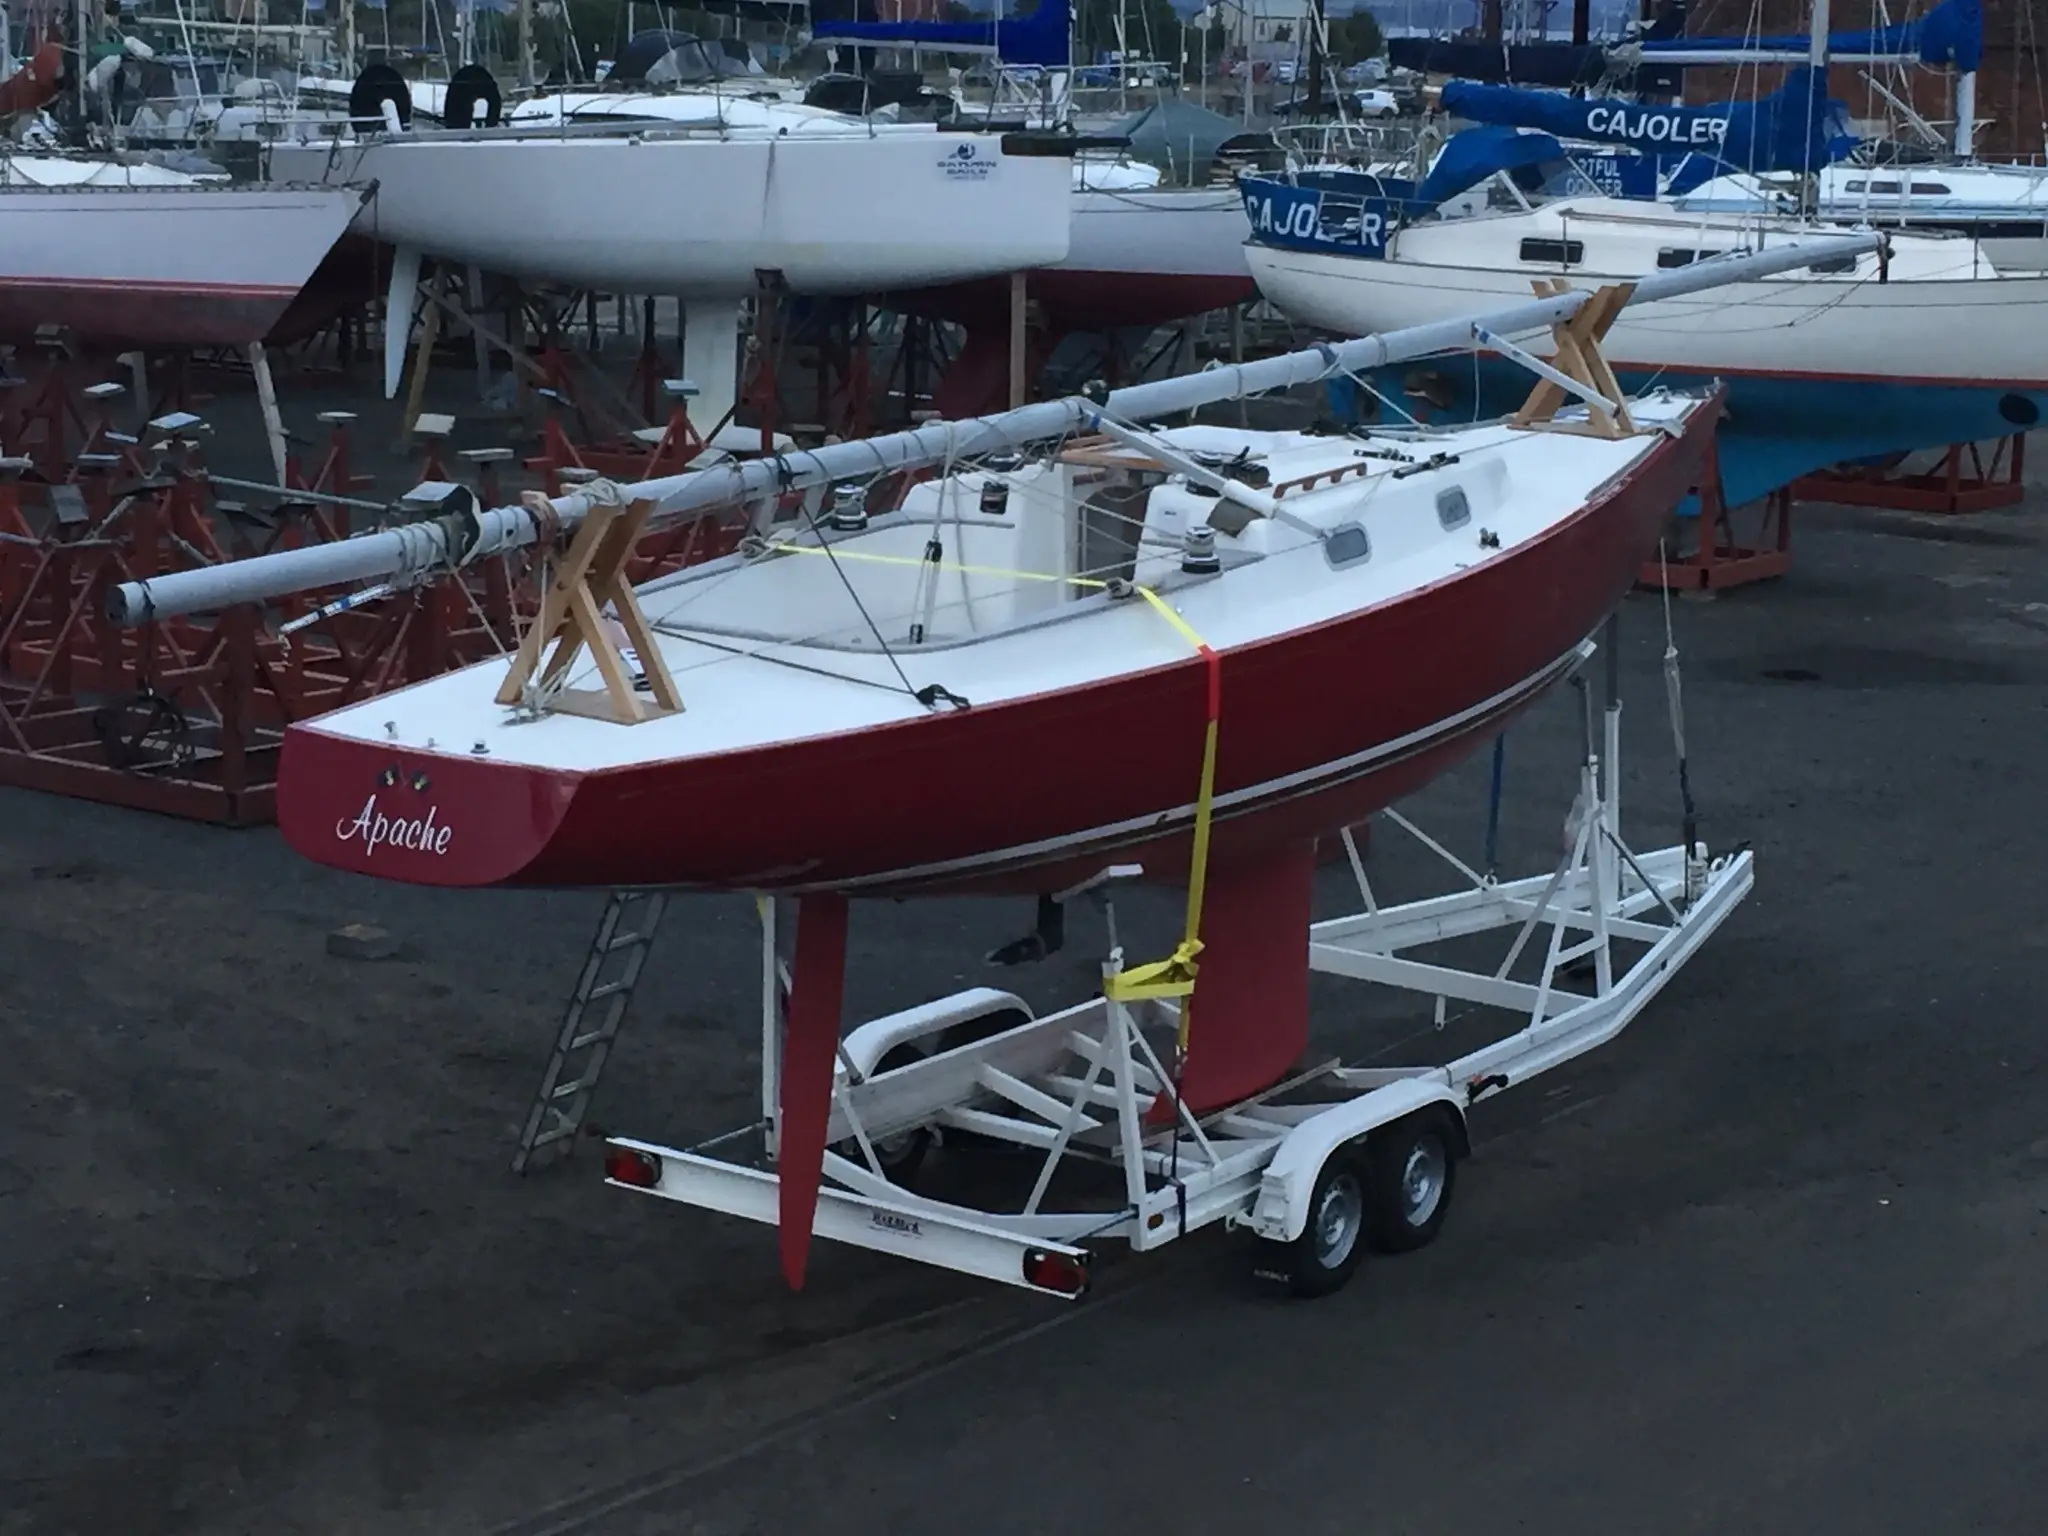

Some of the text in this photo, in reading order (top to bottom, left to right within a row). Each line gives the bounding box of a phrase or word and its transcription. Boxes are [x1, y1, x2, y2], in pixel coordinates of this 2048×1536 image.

[1587, 107, 1728, 144] CAJOLER
[1246, 195, 1382, 247] CAJOLR
[335, 793, 452, 857] Apache
